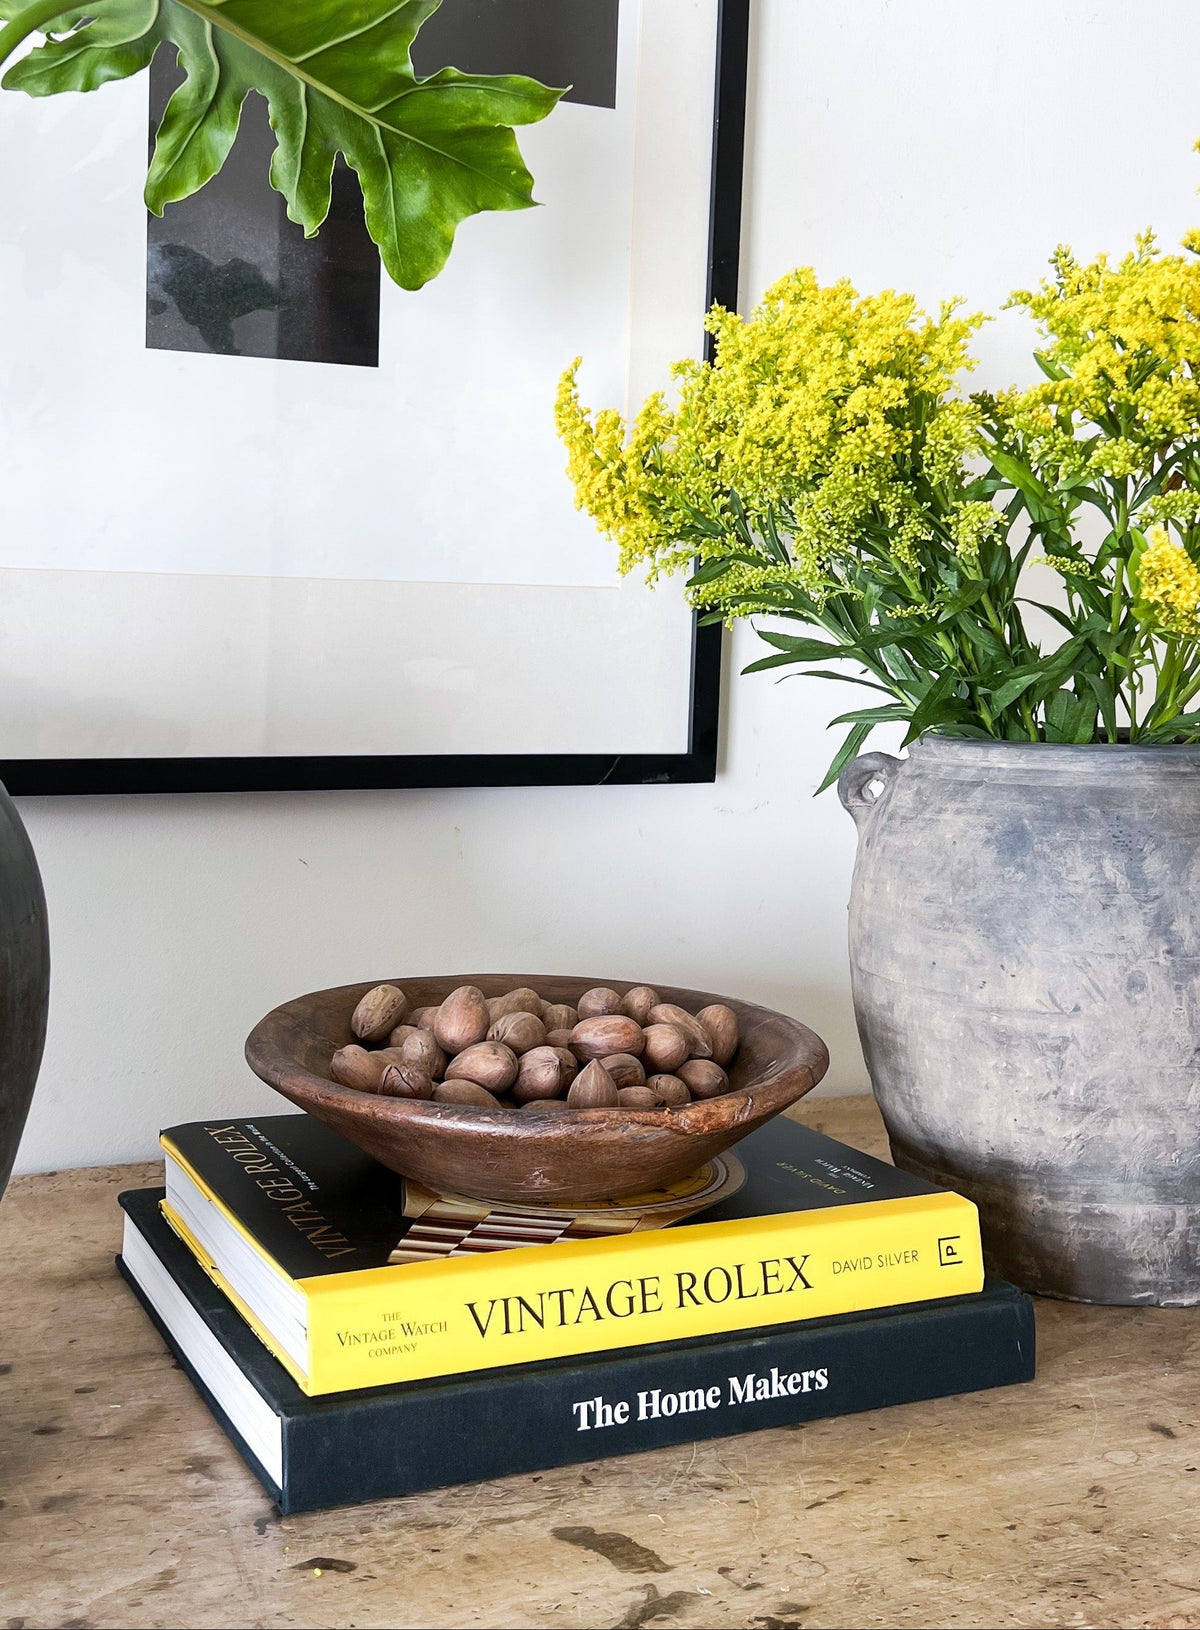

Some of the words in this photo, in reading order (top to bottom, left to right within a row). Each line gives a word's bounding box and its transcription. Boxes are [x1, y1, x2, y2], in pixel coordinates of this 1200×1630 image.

[203, 1125, 281, 1175] ROLEX
[775, 1161, 813, 1179] SILVER
[809, 1178, 848, 1195] DAVID
[255, 1177, 358, 1259] VINTAGE
[832, 1256, 873, 1275] DAVID
[877, 1249, 919, 1268] SILVER
[464, 1276, 664, 1339] VINTAGE
[673, 1254, 815, 1309] ROLEX
[381, 1311, 402, 1323] THE
[368, 1342, 418, 1358] COMPANY
[572, 1396, 630, 1432] The
[637, 1388, 721, 1421] Home
[727, 1367, 829, 1405] Makers
